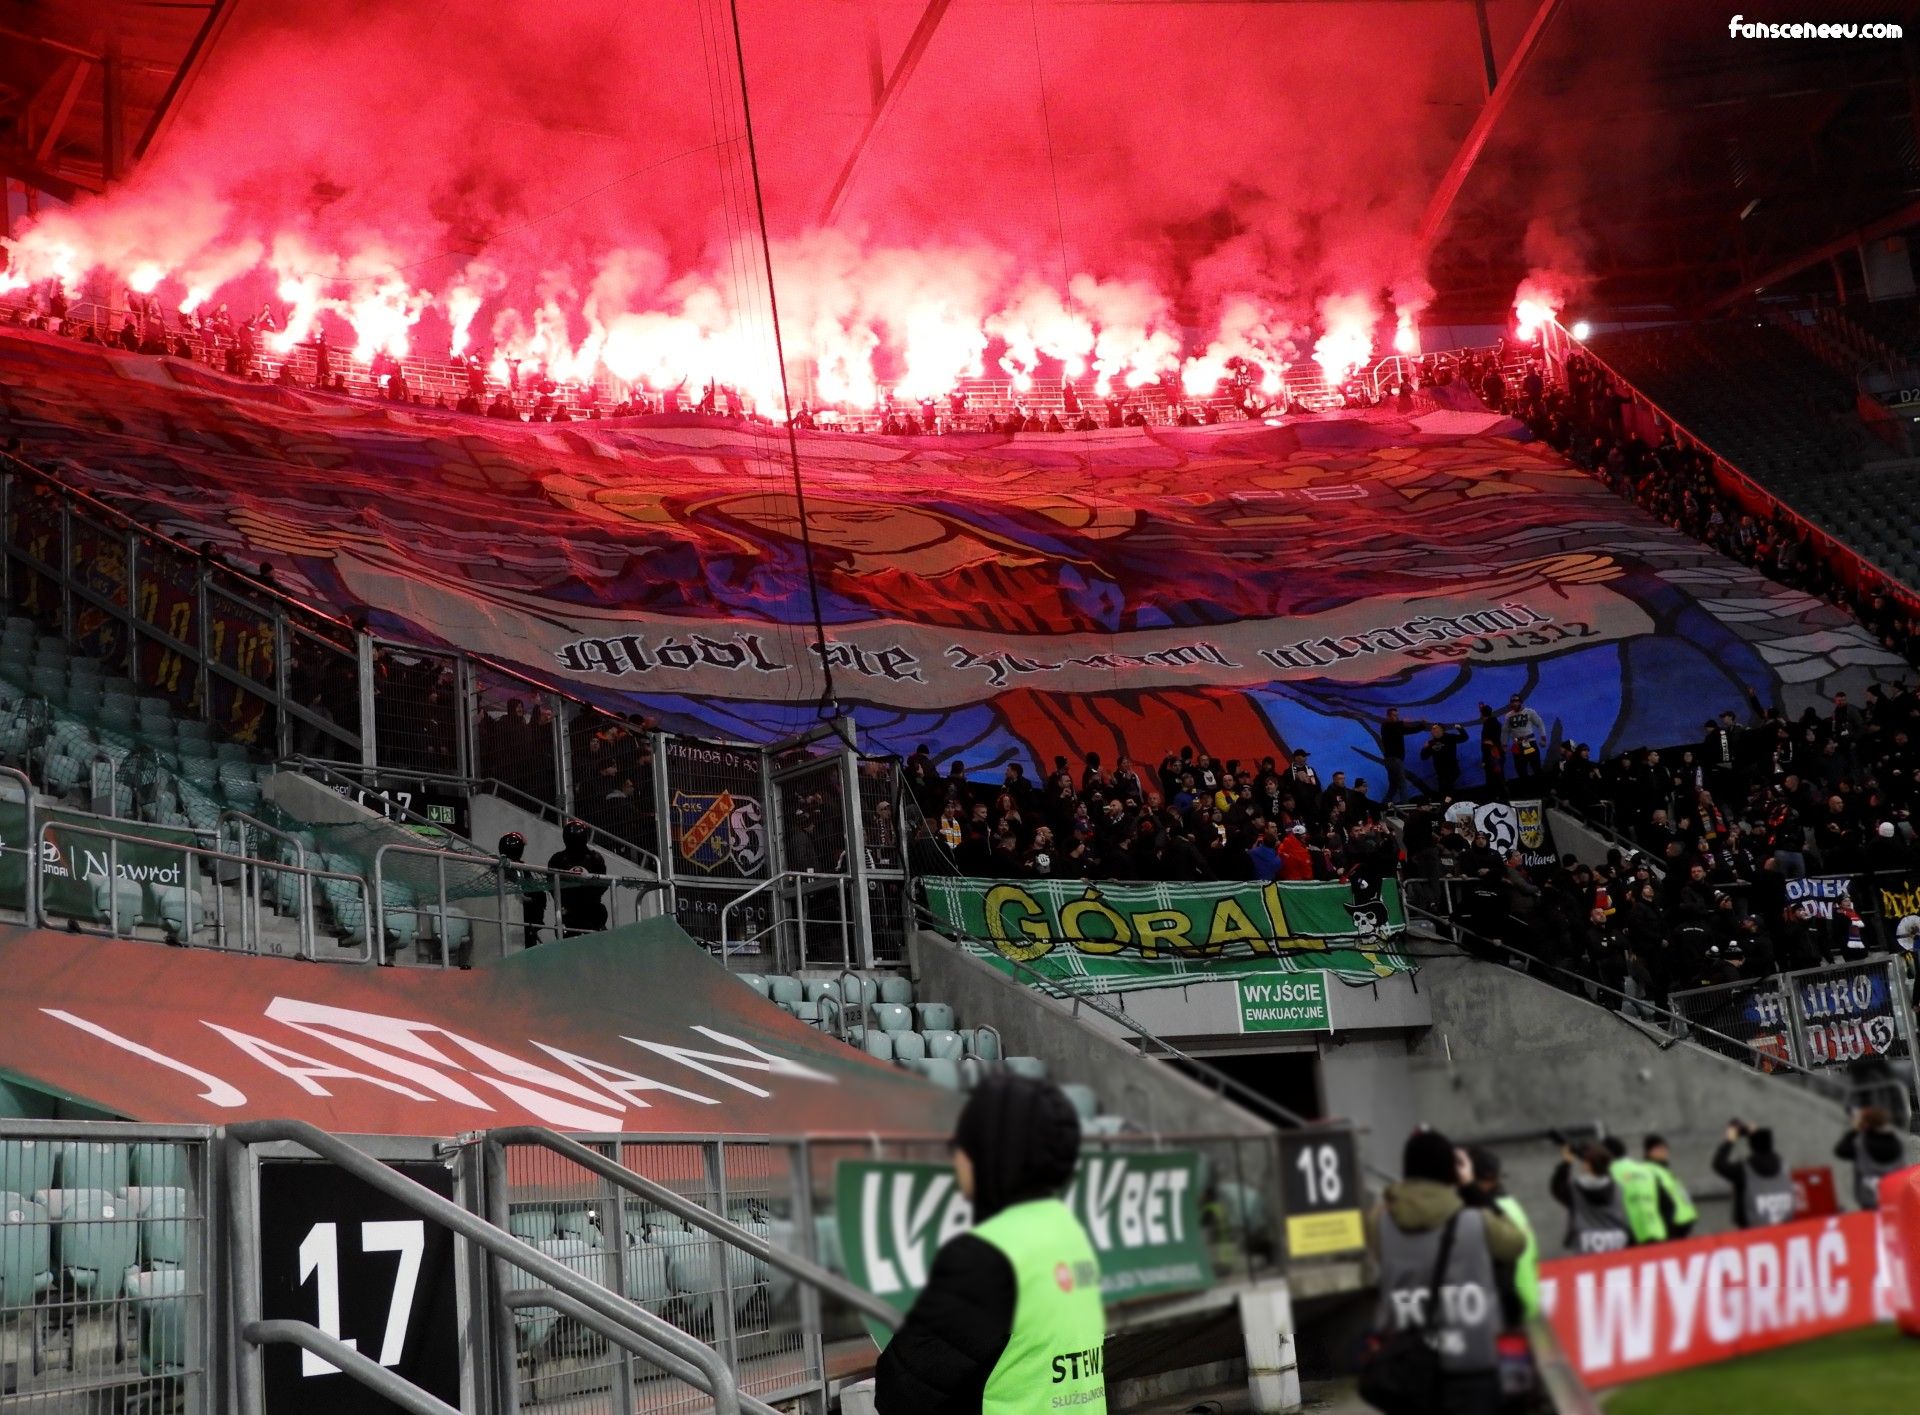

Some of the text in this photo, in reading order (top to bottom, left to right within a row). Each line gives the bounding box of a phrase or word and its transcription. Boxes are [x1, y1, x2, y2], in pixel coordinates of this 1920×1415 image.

[82, 849, 181, 884] Nawrot
[983, 881, 1331, 961] GÓRAL
[1243, 980, 1322, 1003] WYJŚCIE
[1246, 1006, 1324, 1021] EWAKUACYJNE
[1297, 1145, 1342, 1203] 18
[300, 1220, 425, 1377] 17
[1577, 1216, 1849, 1375] WYGRAĆ
